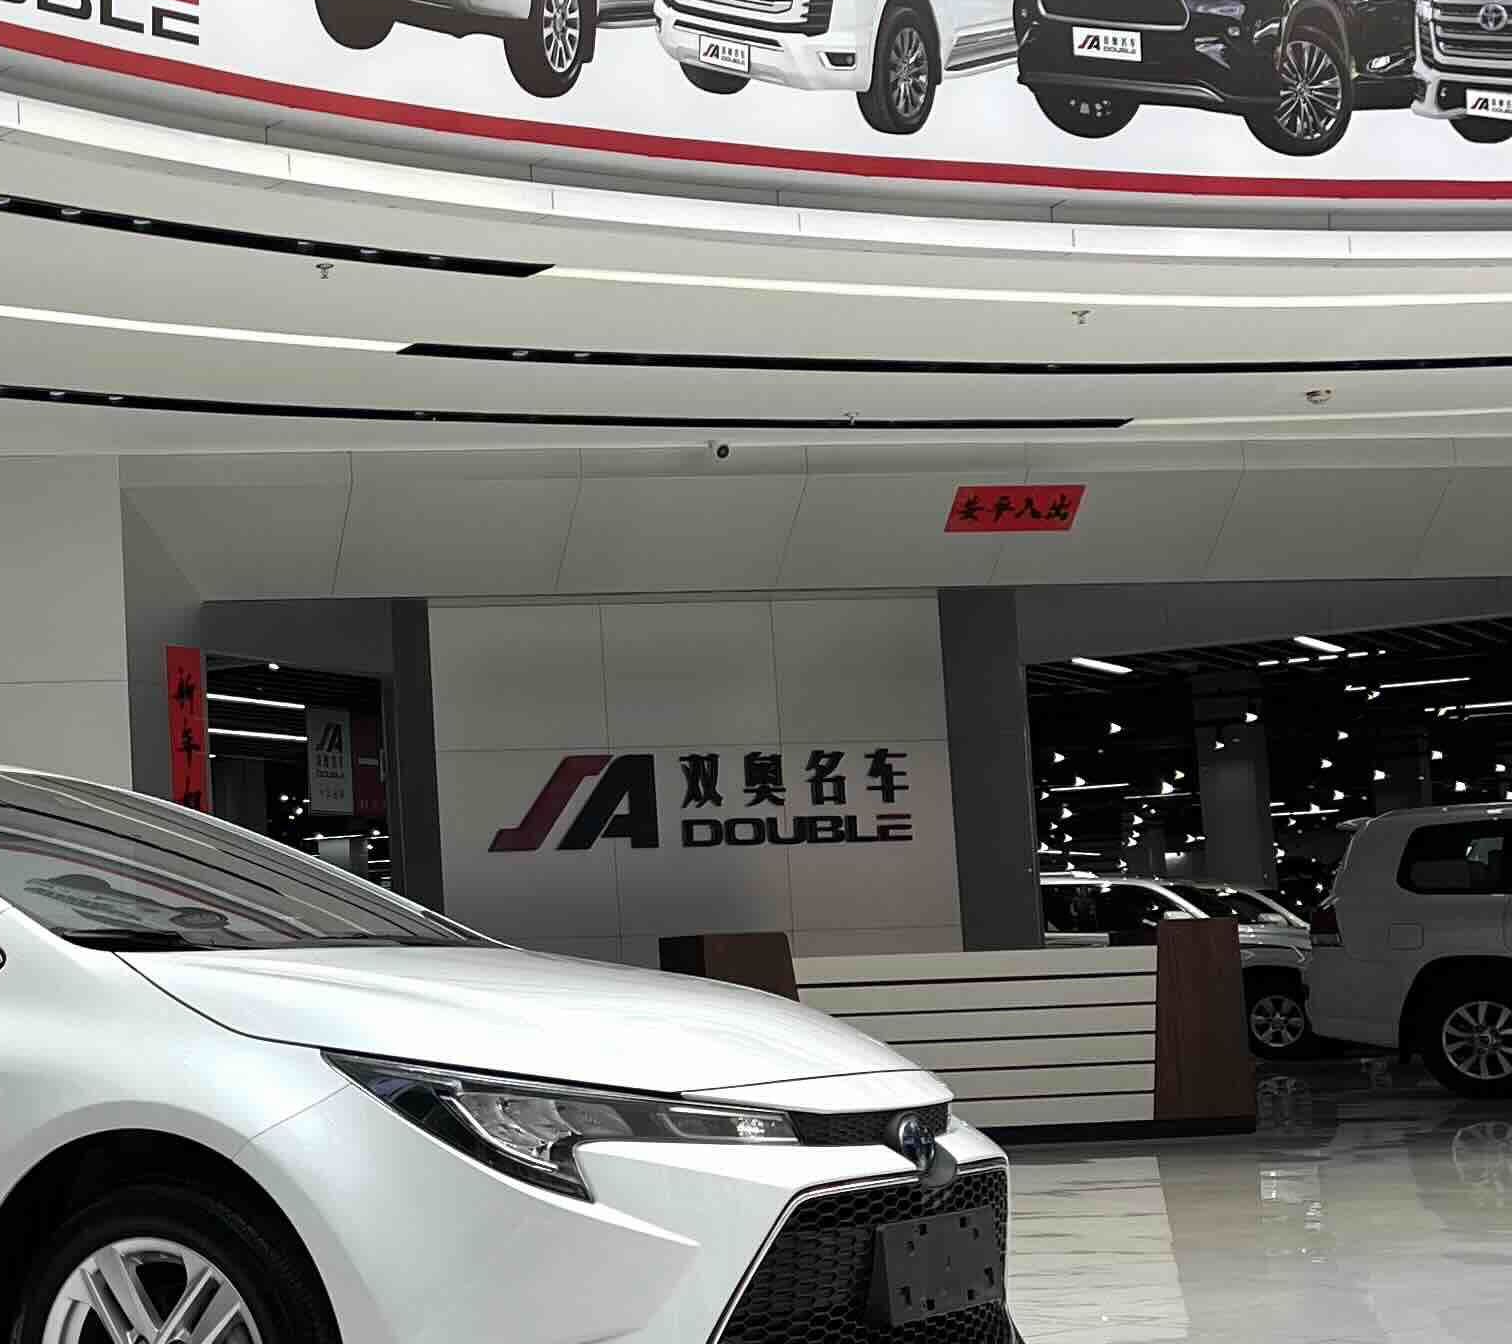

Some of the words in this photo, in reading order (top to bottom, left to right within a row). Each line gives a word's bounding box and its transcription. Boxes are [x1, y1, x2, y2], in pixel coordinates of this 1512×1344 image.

[679, 748, 910, 808] 双奥名车
[681, 813, 913, 848] DOUBLE
